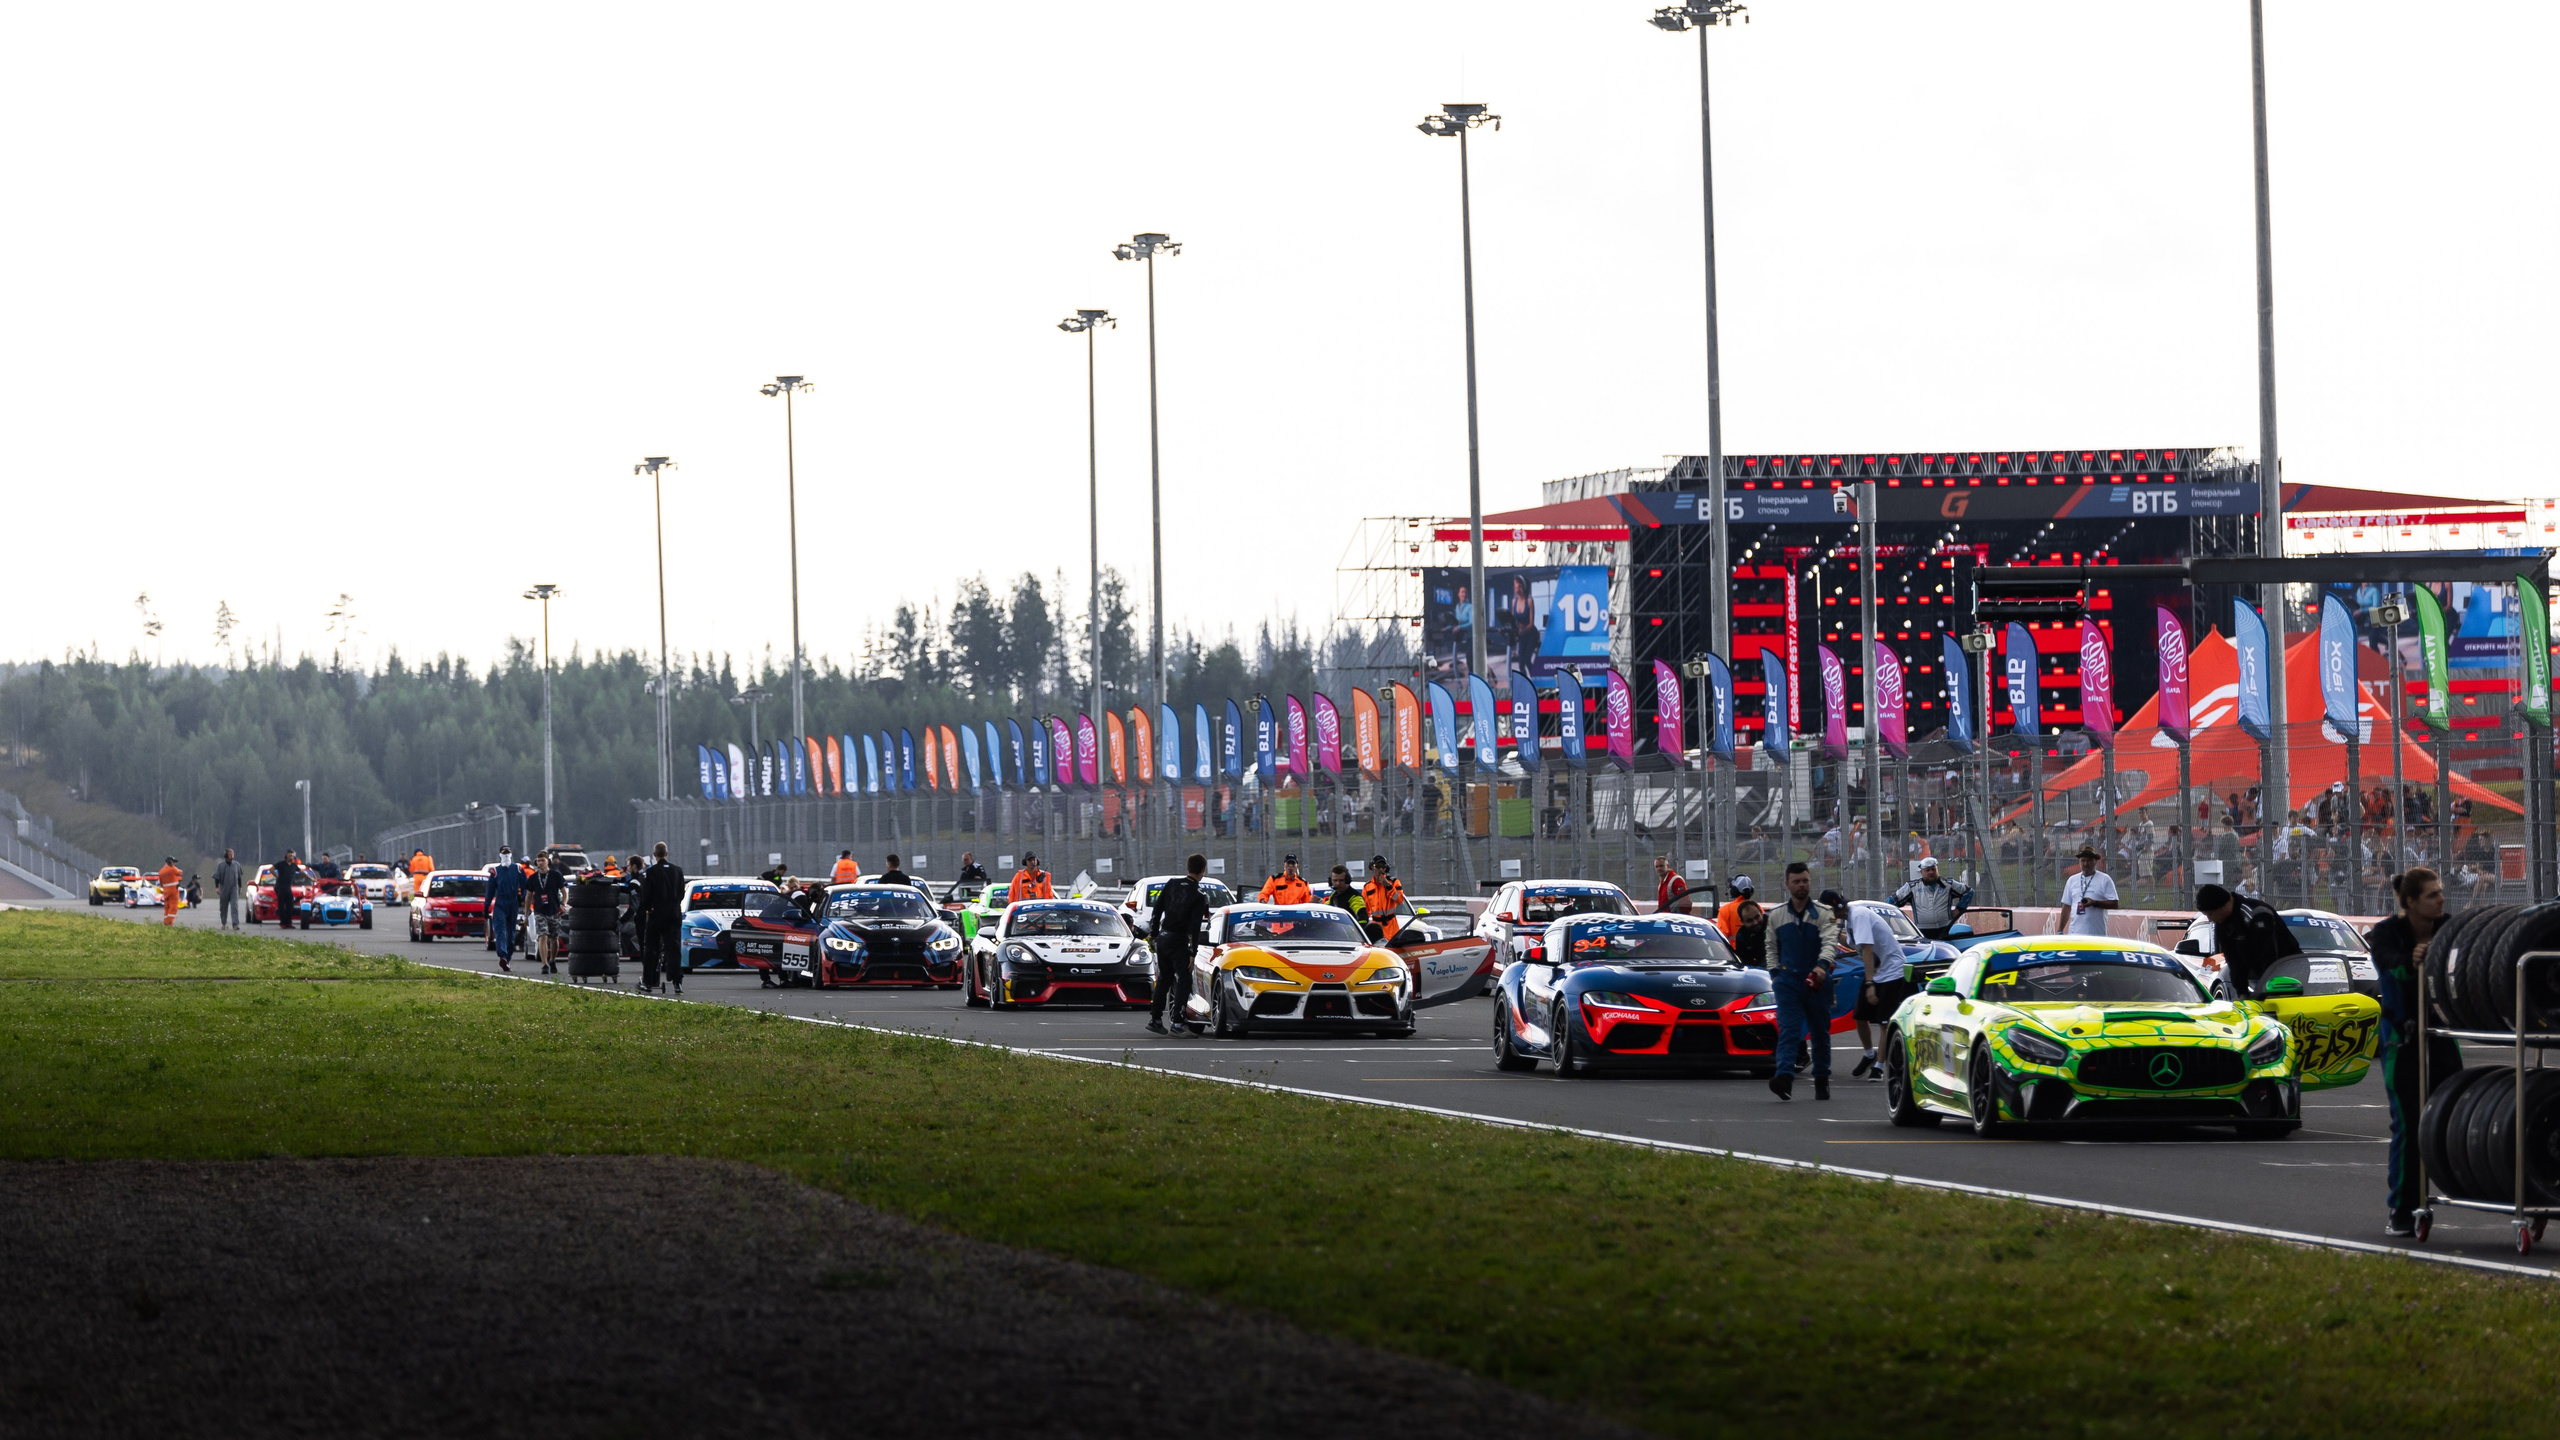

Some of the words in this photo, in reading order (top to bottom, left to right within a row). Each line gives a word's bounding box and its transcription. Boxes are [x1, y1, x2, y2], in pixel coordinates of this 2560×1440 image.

[2191, 487, 2241, 498] Генеральный
[1757, 495, 1808, 505] Генеральный
[2132, 491, 2178, 513] ВТБ
[2191, 500, 2222, 508] спонсор
[1698, 498, 1744, 520] ВБ
[1757, 506, 1789, 515] спонсор
[2294, 516, 2360, 528] GARAGE
[2464, 643, 2495, 651] ОТКРОЙТЕ
[692, 892, 711, 900] 91
[1590, 888, 1614, 896] ВТБ
[830, 899, 859, 910] 555
[1082, 904, 1107, 912] ВТБ
[1310, 911, 1340, 921] ВТБ
[1873, 906, 1897, 916] ВТБ
[1017, 914, 1028, 922] 5
[2308, 918, 2339, 929] ВТБ
[1671, 924, 1706, 936] ВТБ
[782, 953, 809, 967] 555
[2122, 952, 2166, 968] ВТБ
[1984, 970, 2018, 985] 4
[1602, 1012, 1640, 1021] YOKOHAMA
[2292, 1017, 2317, 1035] the
[2295, 1014, 2379, 1071] BEAST
